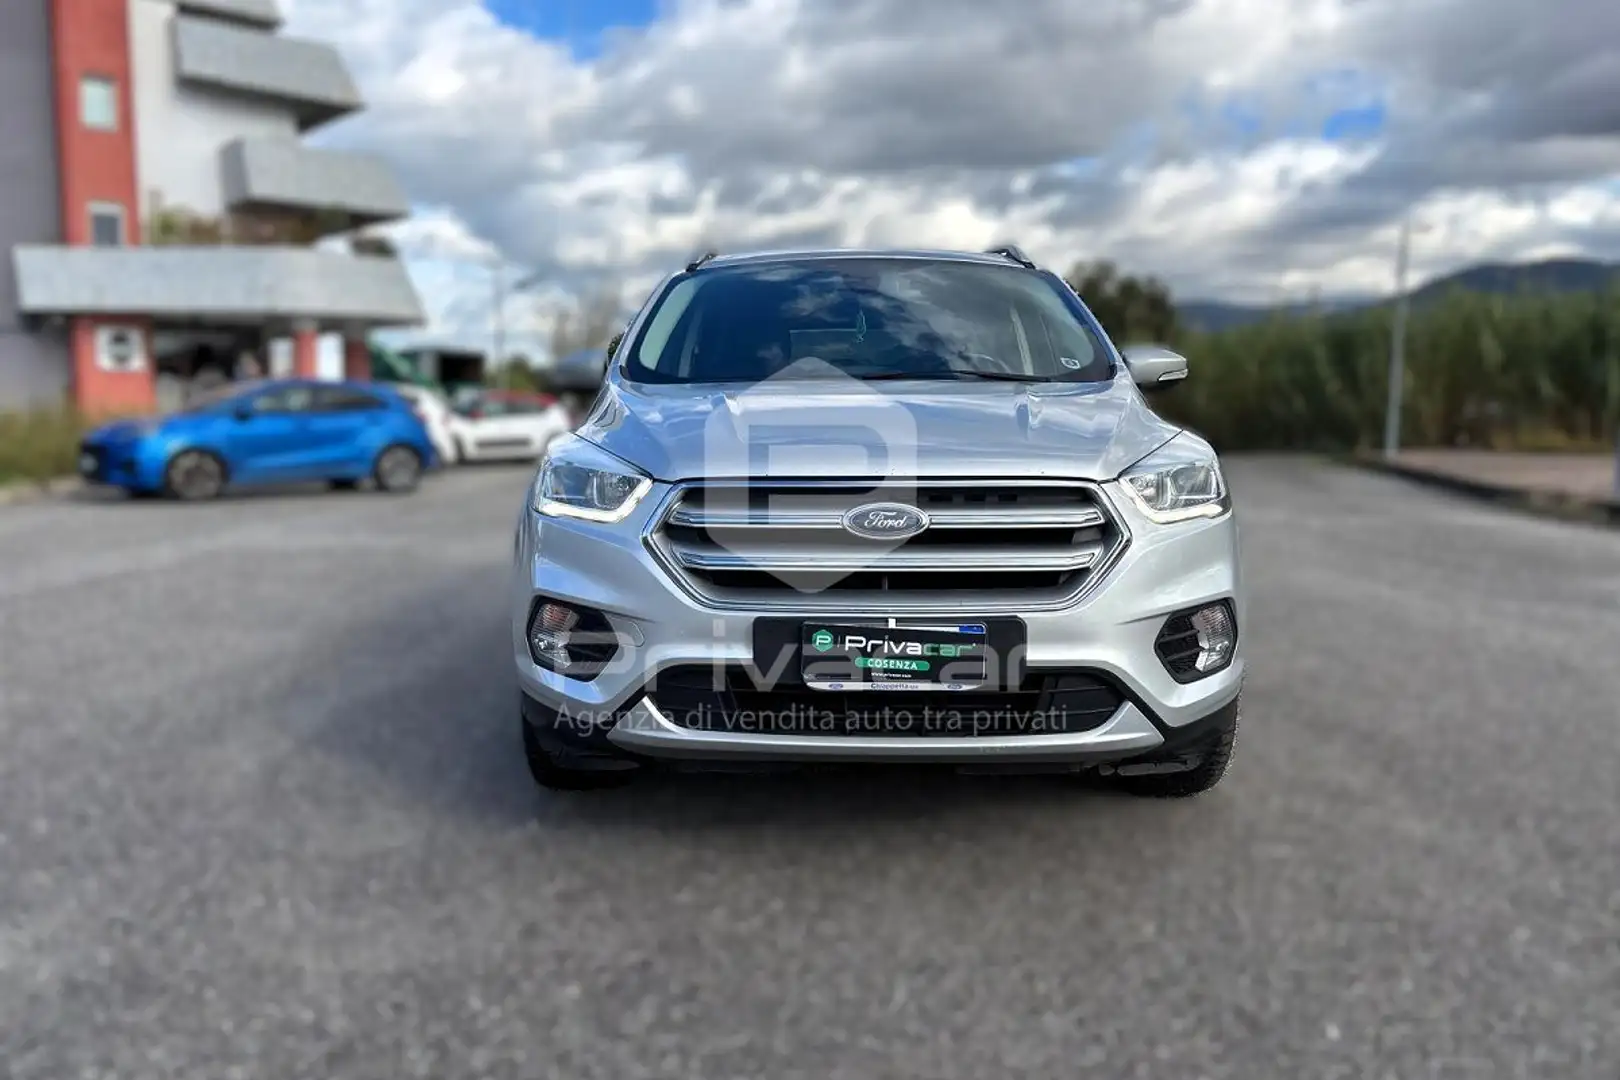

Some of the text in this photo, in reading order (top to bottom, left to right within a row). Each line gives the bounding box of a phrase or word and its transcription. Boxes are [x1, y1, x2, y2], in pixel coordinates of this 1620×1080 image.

[864, 511, 908, 529] Ford
[844, 634, 975, 657] Privacar
[867, 658, 918, 670] COSENZA
